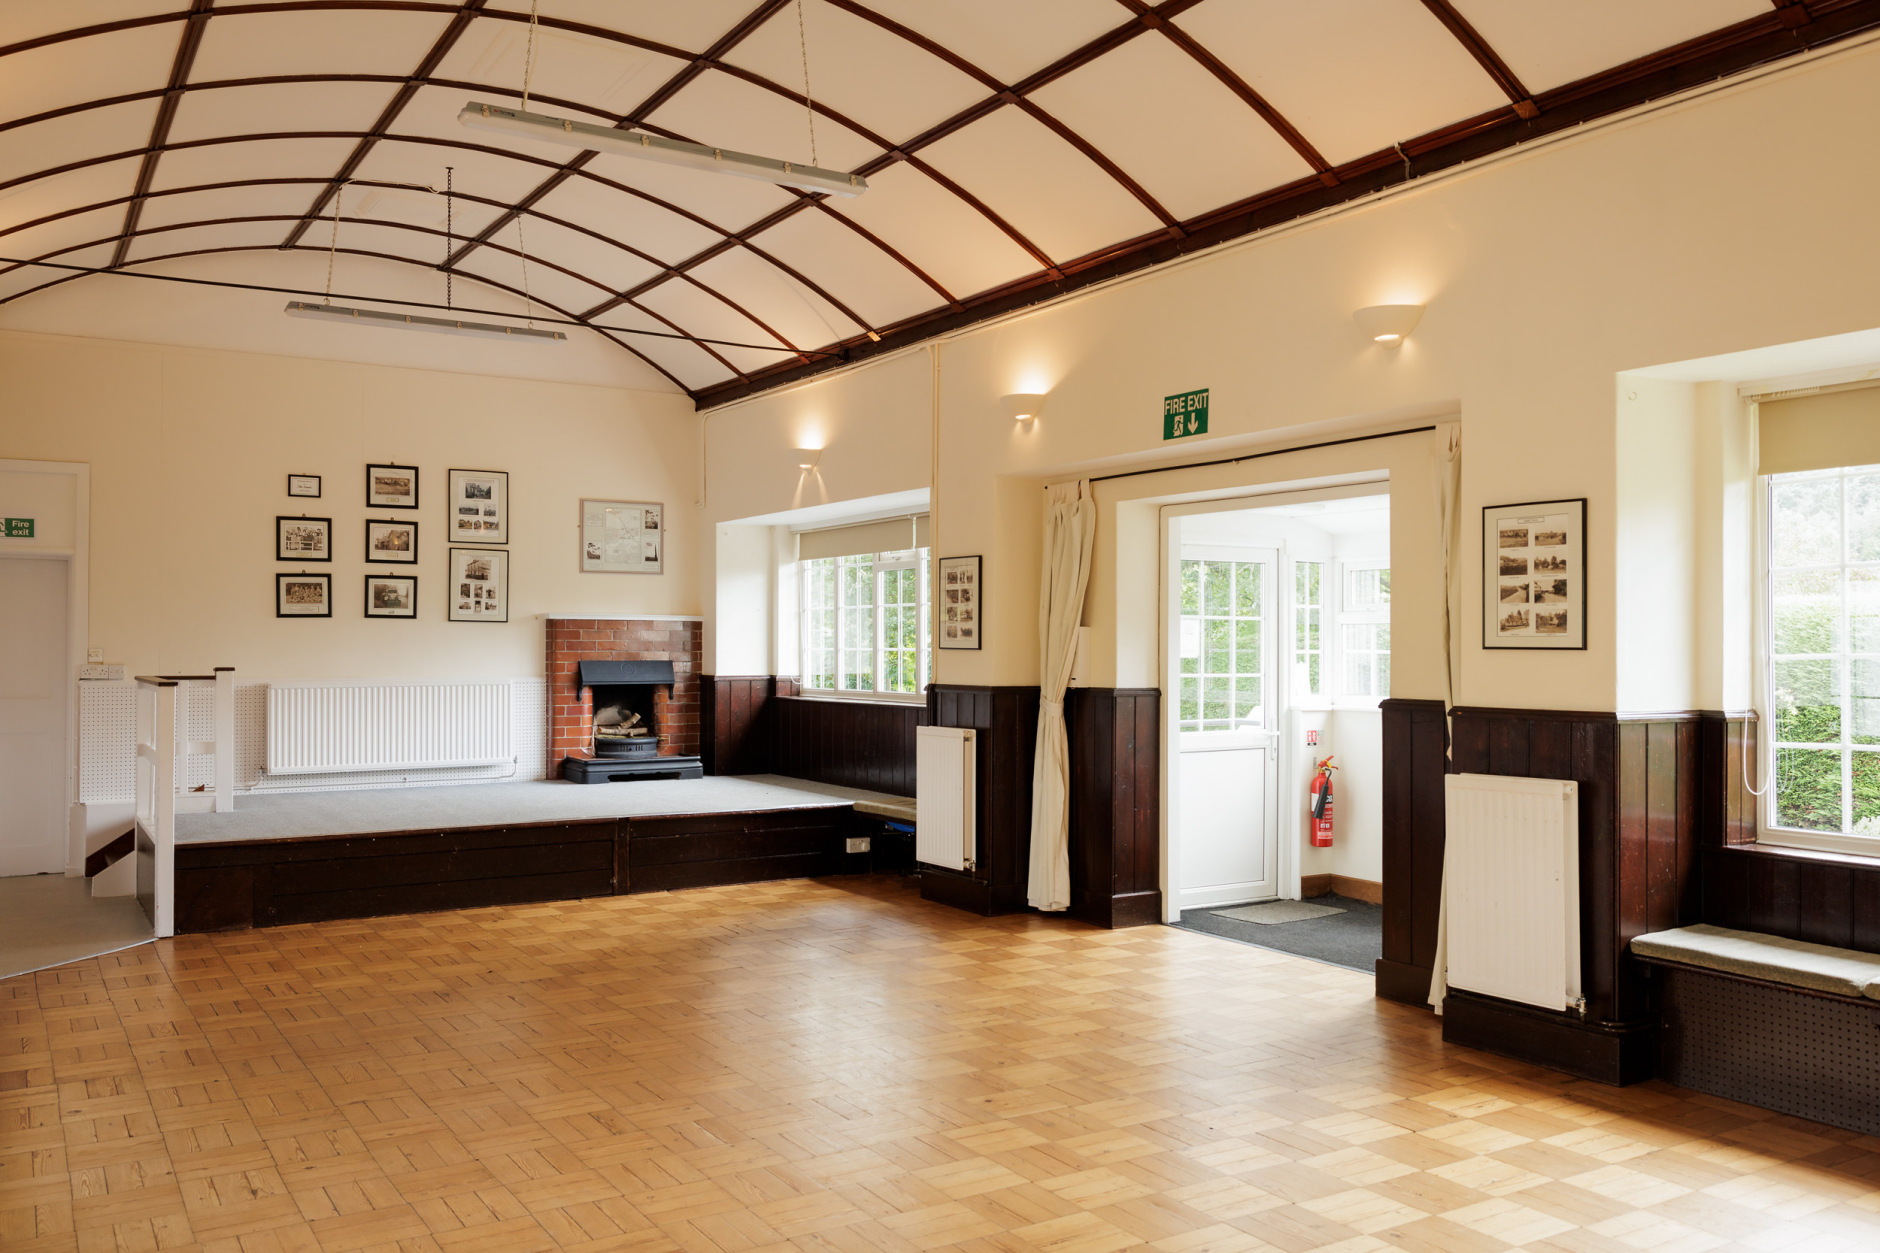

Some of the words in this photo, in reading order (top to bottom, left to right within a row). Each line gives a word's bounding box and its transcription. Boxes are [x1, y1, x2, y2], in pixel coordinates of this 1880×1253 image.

[1165, 397, 1186, 415] FIRE
[1188, 392, 1209, 411] EXIT
[12, 520, 30, 528] Fire
